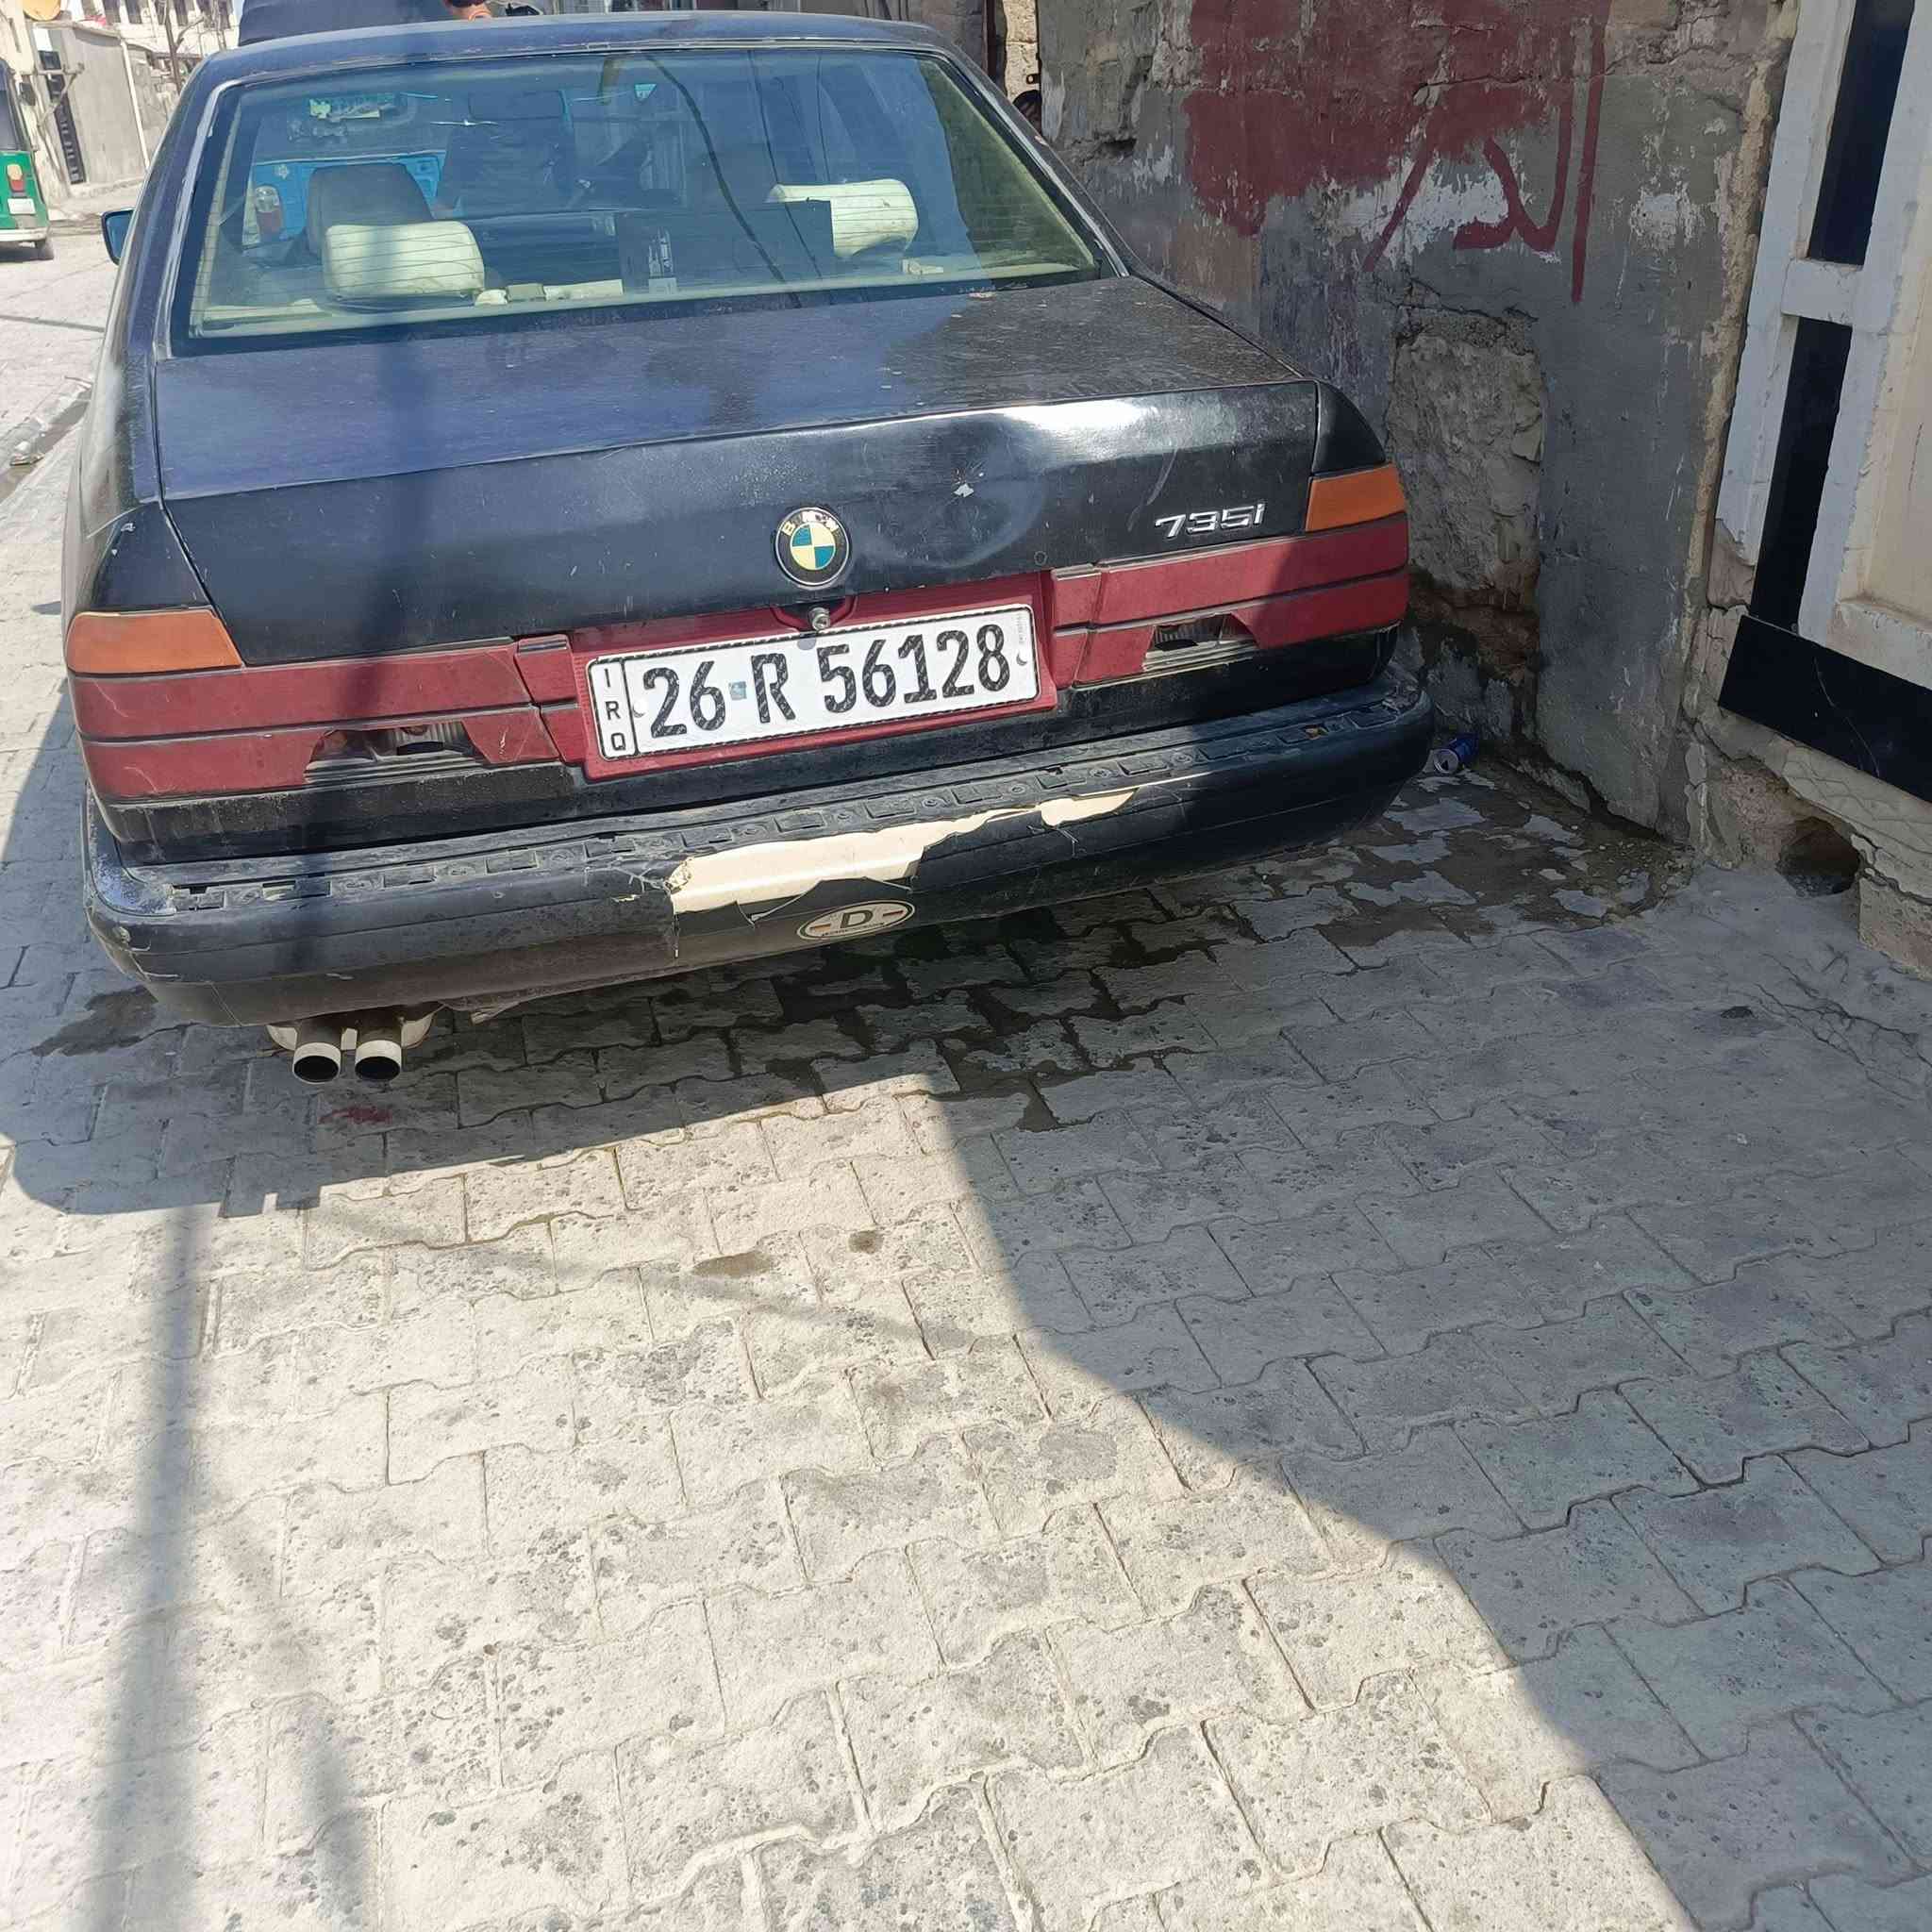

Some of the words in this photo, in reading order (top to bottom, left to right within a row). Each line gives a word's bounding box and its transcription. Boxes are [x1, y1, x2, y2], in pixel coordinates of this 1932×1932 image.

[605, 668, 626, 751] IRQ
[643, 660, 726, 738] 26
[751, 652, 795, 724] R
[817, 624, 1011, 713] 56128
[840, 909, 873, 929] D
